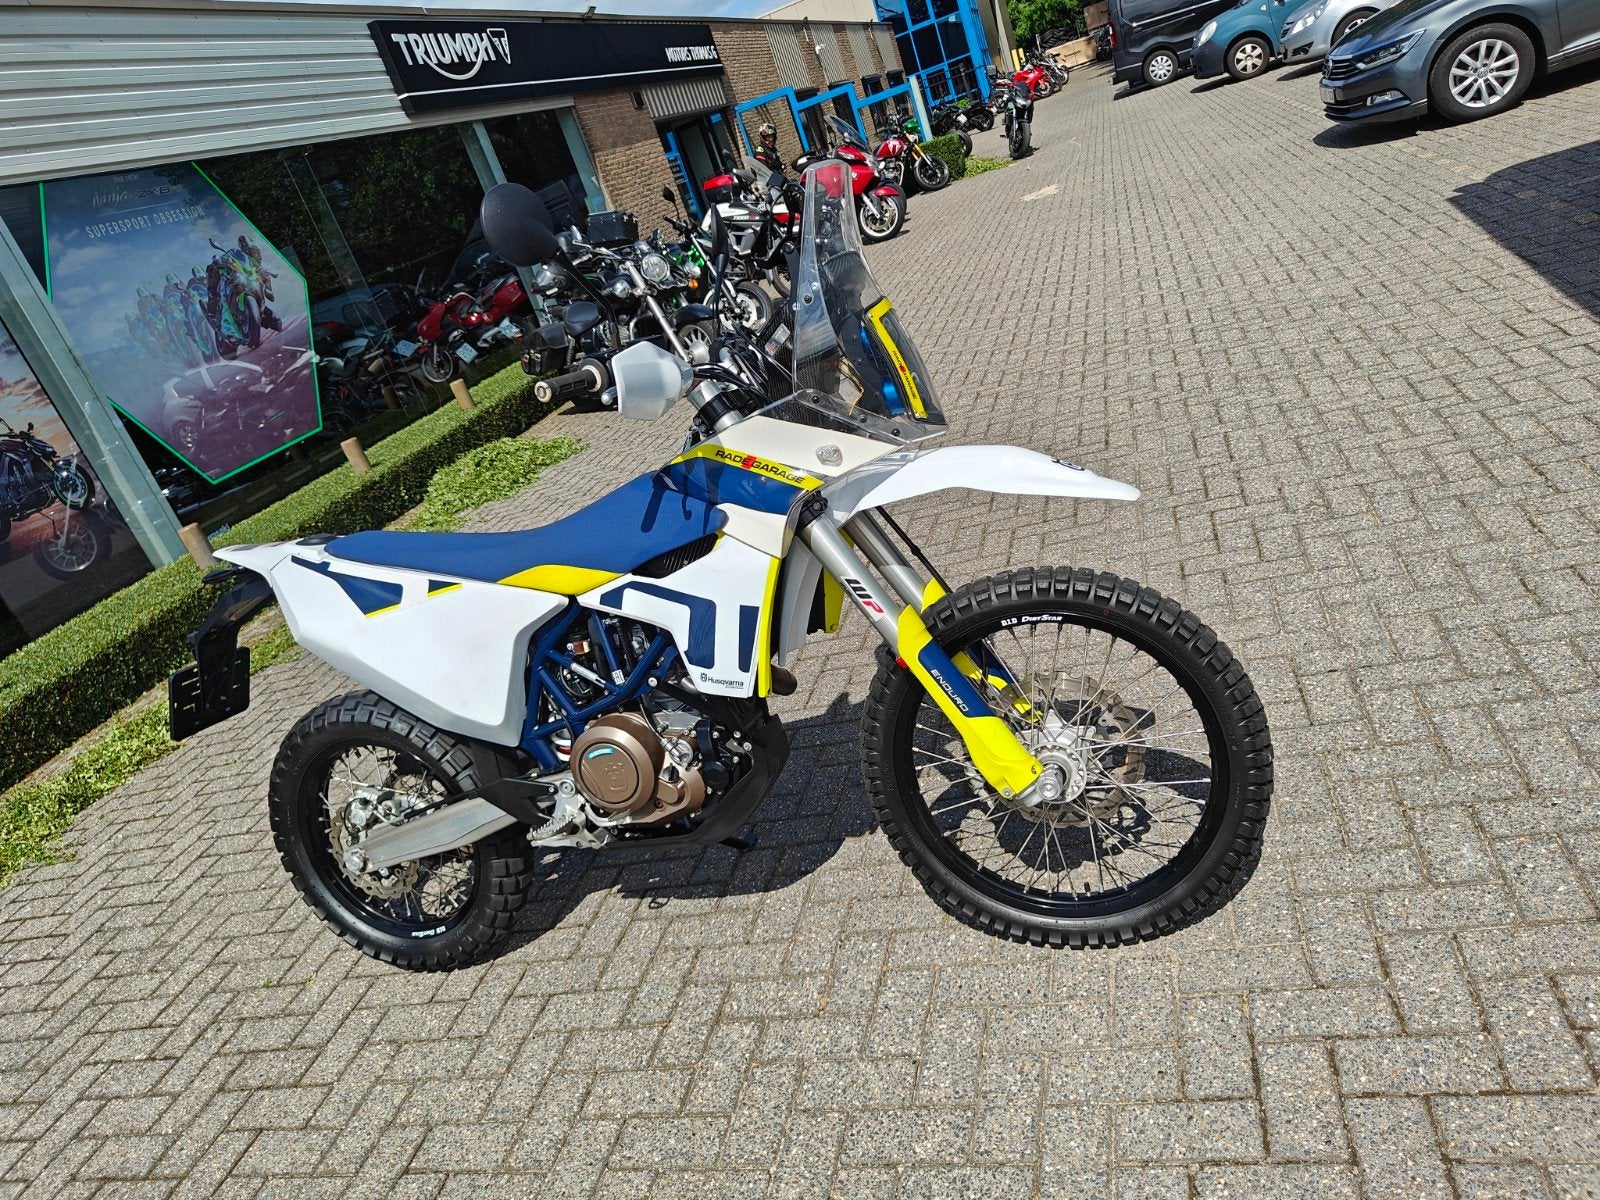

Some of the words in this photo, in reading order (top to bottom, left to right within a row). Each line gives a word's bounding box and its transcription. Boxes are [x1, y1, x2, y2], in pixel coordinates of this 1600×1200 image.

[391, 32, 497, 80] TRIUMPH
[665, 46, 692, 62] MOTORS
[92, 186, 128, 208] Ninja
[85, 215, 152, 239] SUPERSPORT
[153, 204, 206, 225] OBSESSION
[708, 676, 744, 687] Husqvarna
[930, 669, 970, 712] ENDURO
